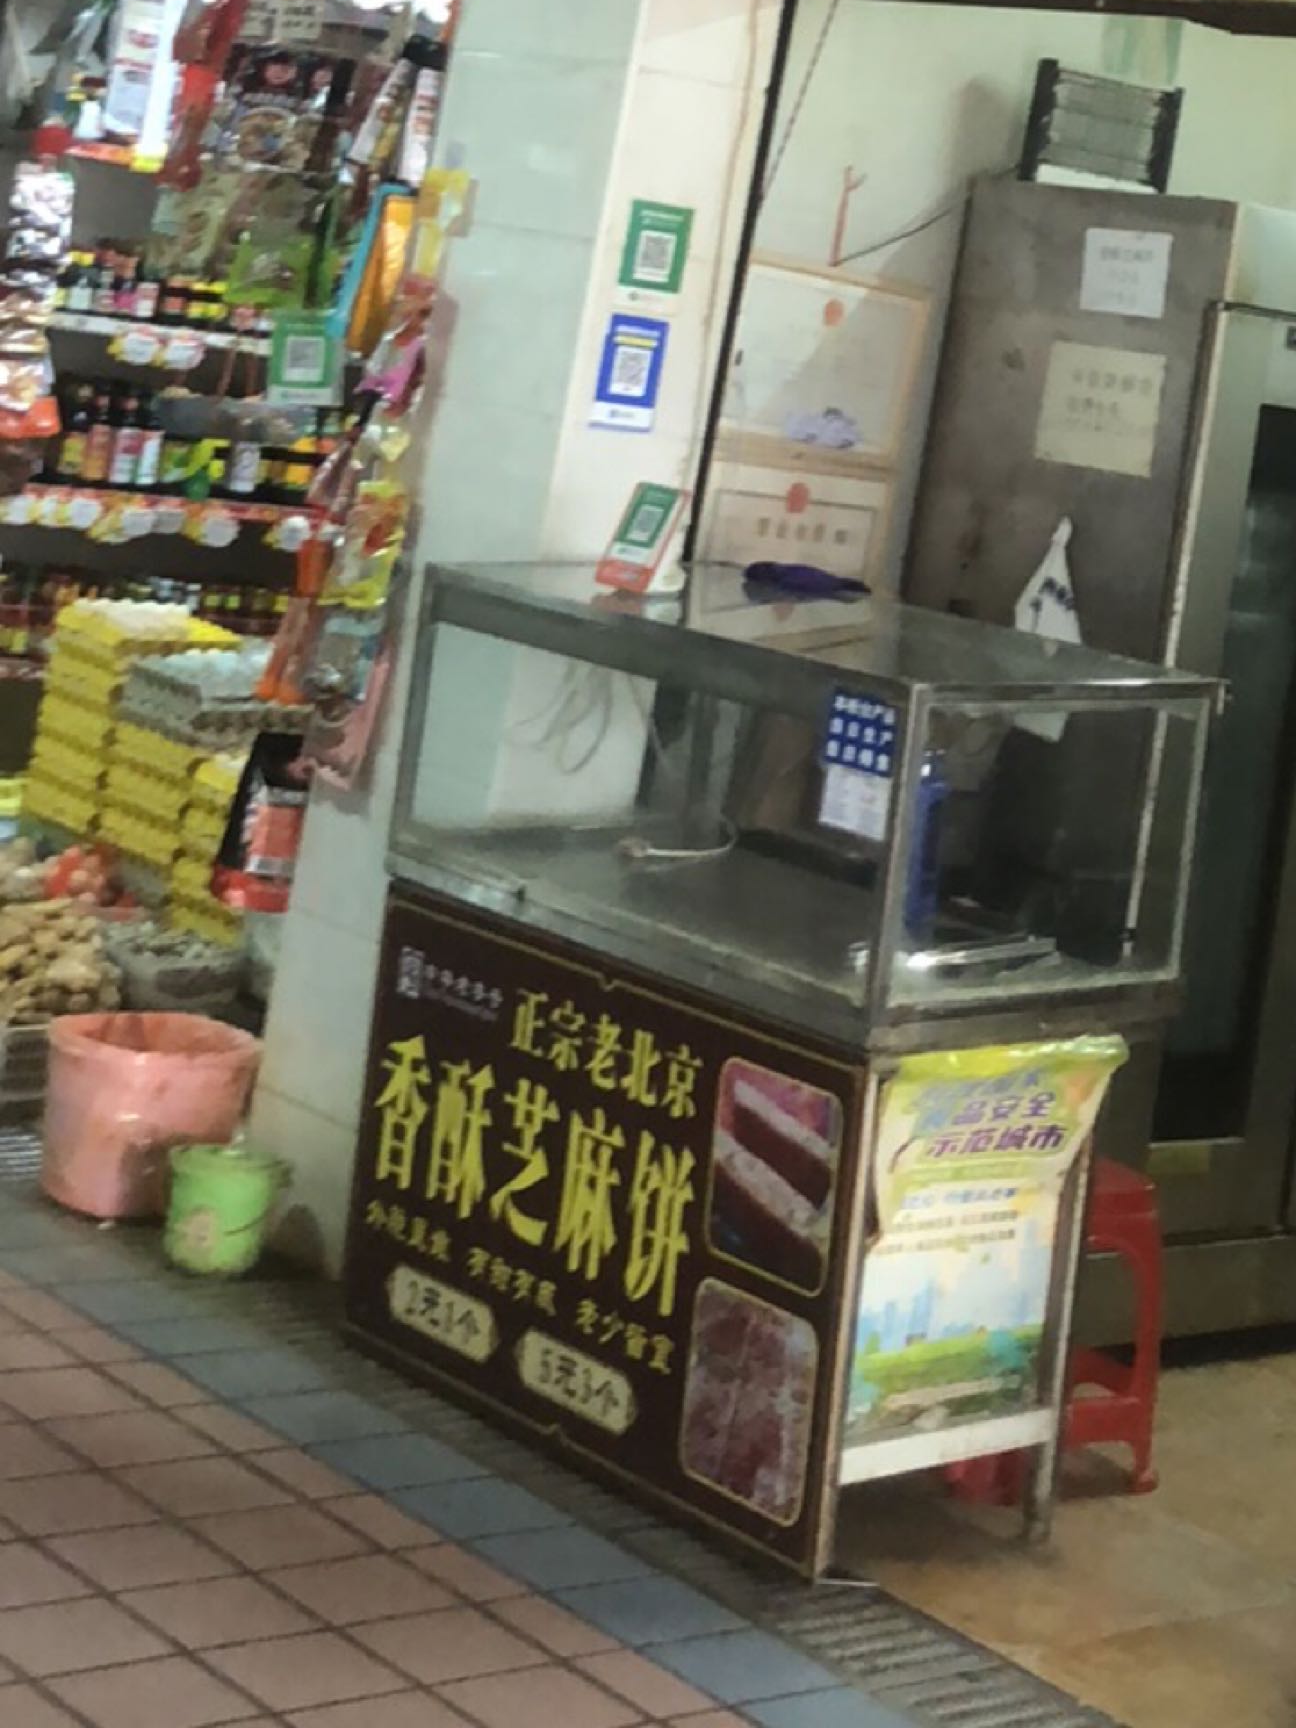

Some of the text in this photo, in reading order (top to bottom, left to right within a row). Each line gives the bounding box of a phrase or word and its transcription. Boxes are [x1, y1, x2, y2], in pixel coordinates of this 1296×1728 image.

[511, 988, 703, 1120] 正宗老北京
[374, 1035, 696, 1317] 香酥芝麻饼
